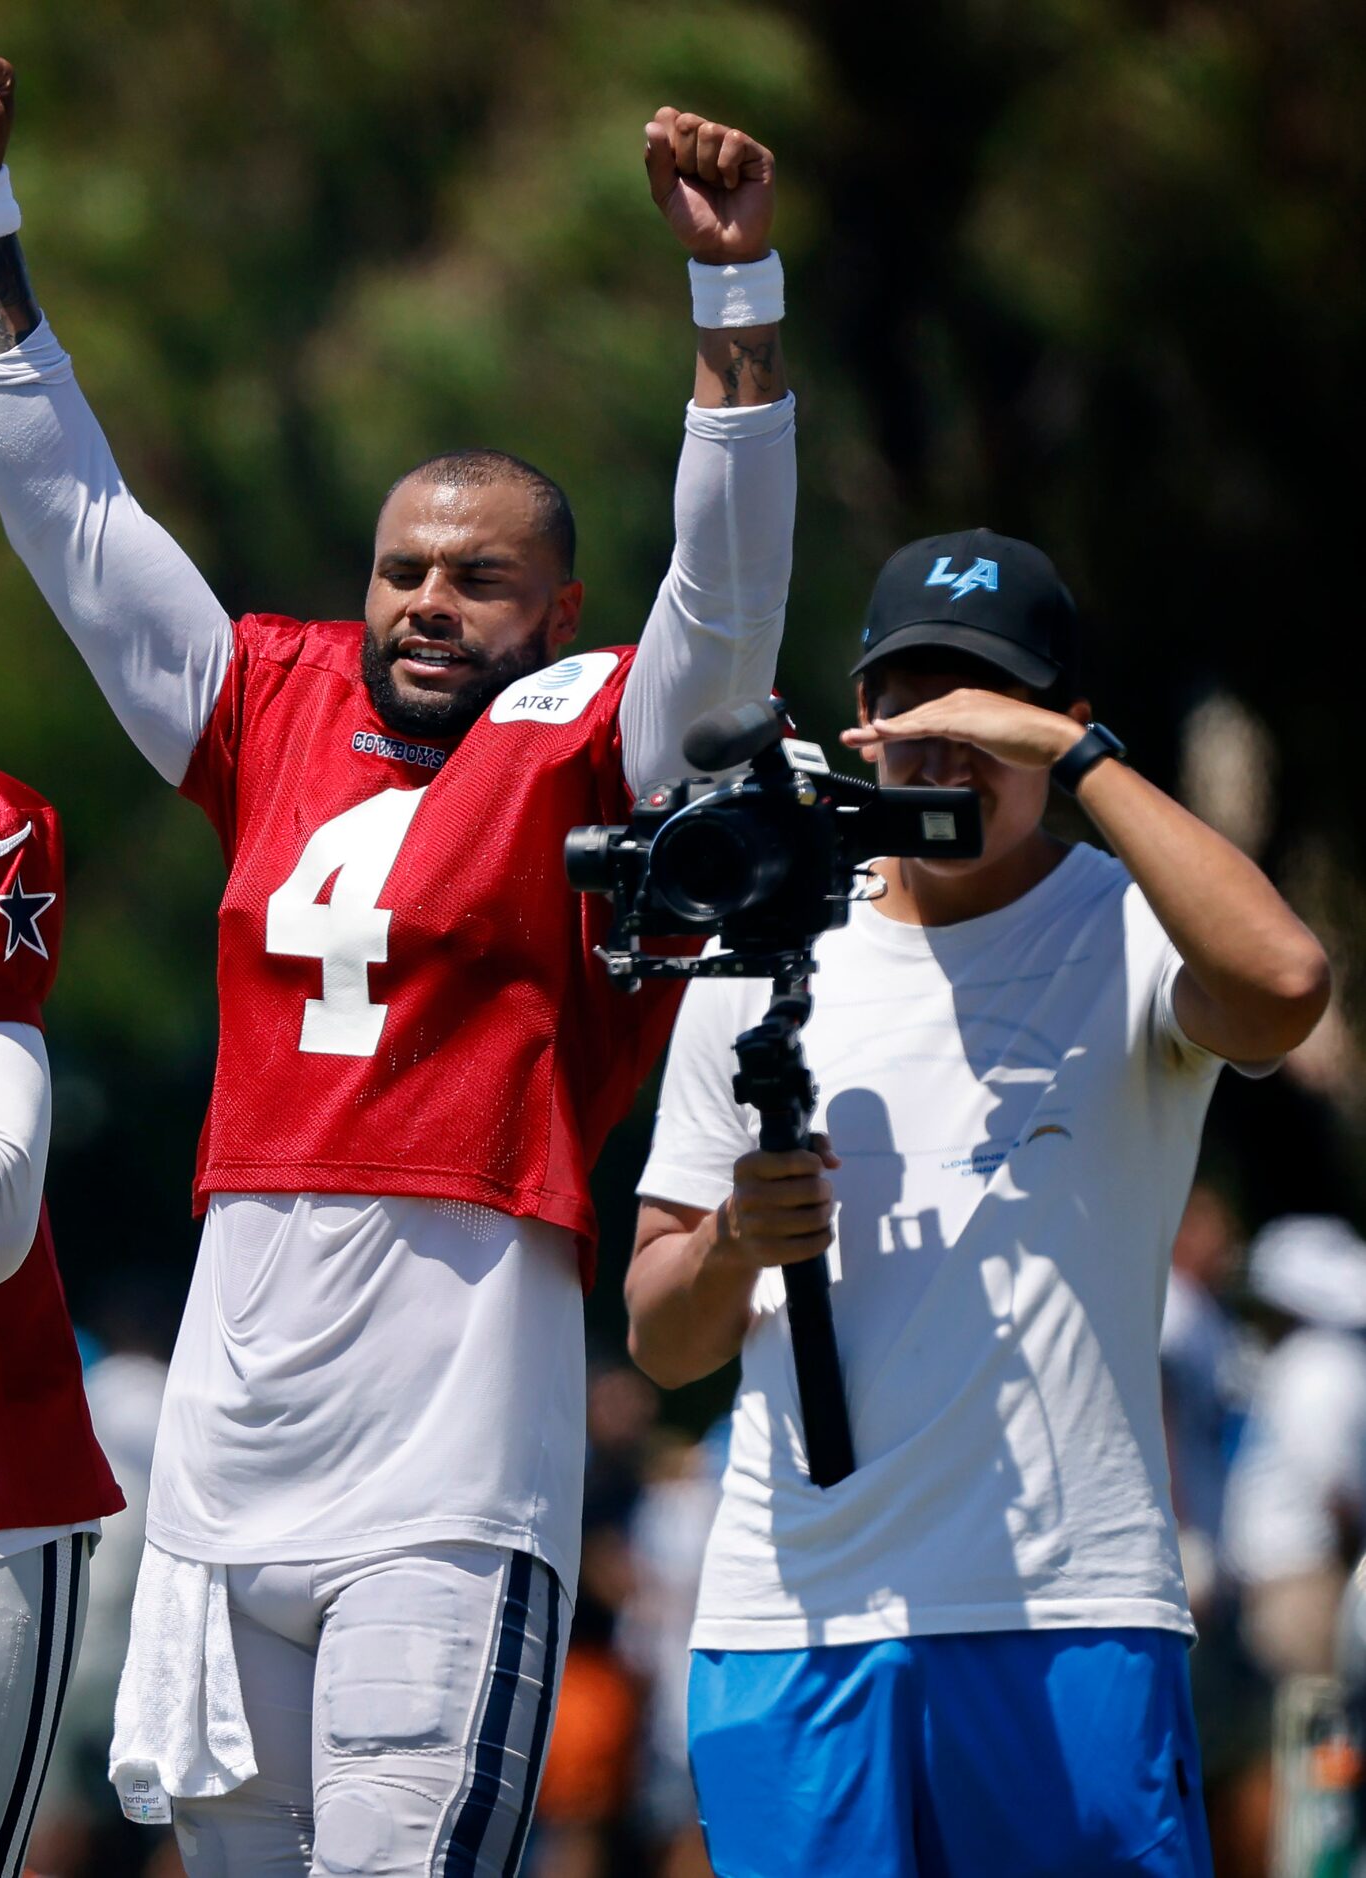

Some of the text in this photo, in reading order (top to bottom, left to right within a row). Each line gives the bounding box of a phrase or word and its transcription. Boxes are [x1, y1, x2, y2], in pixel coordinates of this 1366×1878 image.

[924, 556, 998, 602] LA
[512, 696, 569, 711] AT&T
[352, 731, 445, 769] COWBOYS
[265, 785, 429, 1057] 4
